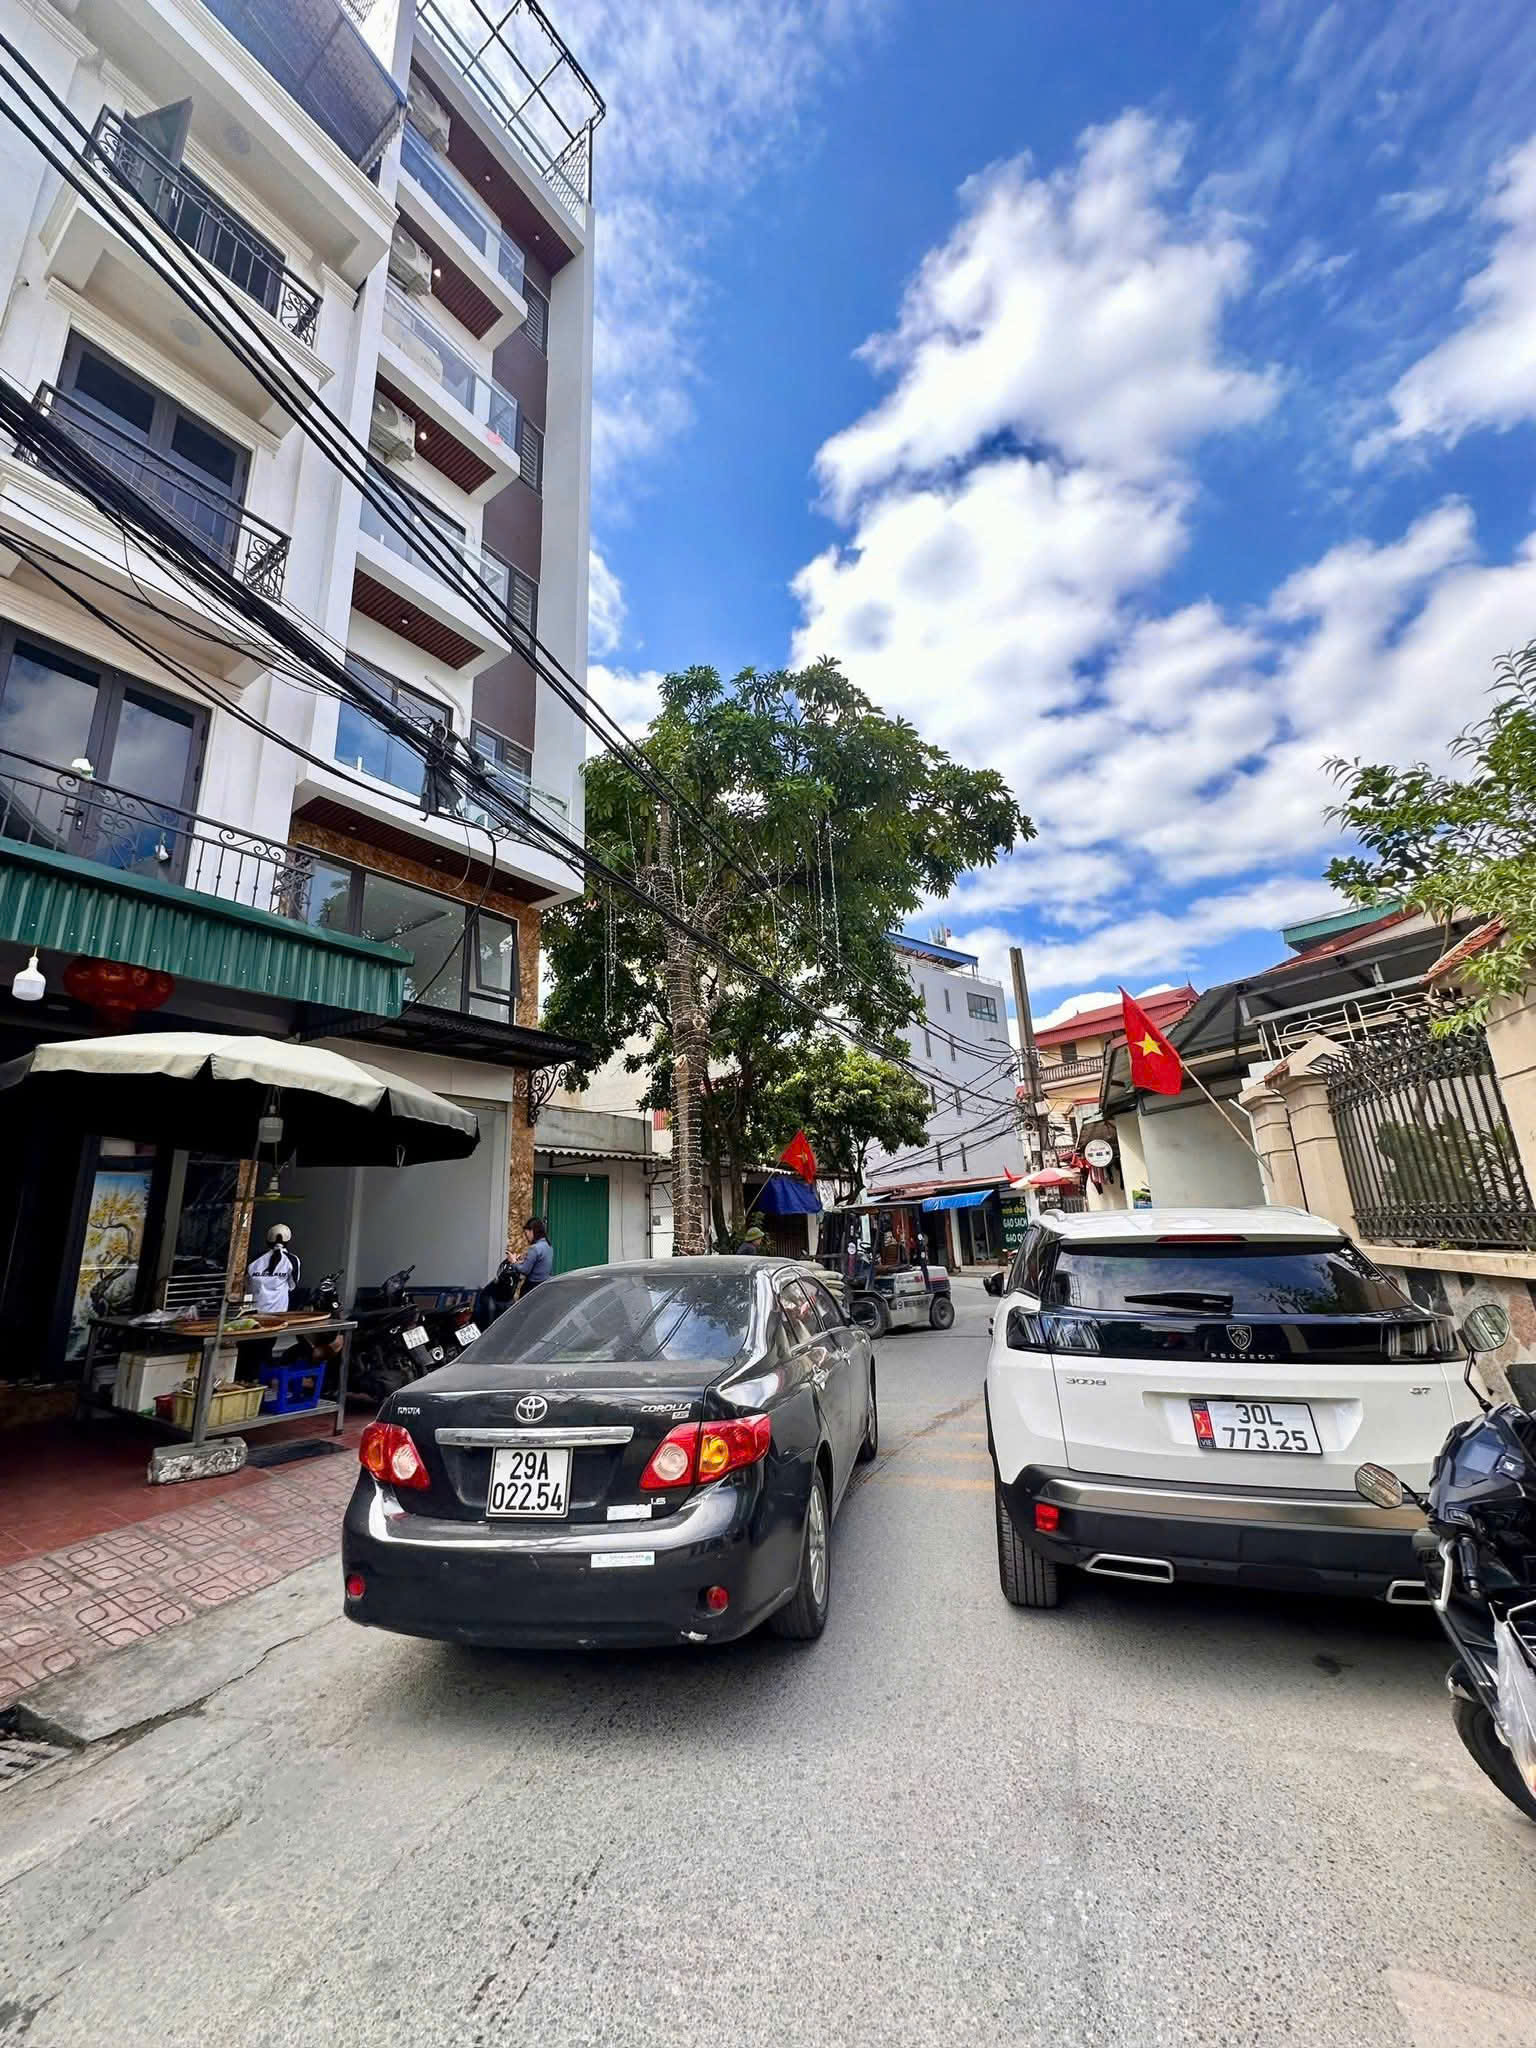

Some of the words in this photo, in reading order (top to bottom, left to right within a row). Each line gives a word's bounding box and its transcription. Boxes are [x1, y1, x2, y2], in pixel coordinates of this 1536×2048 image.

[1210, 1352, 1275, 1360] PEUGEOT
[1065, 1377, 1106, 1386] 3008
[397, 1406, 420, 1416] TOYOTA
[640, 1402, 692, 1413] COROLLA
[1235, 1404, 1283, 1426] 30L
[1222, 1426, 1308, 1451] 773.25
[510, 1451, 548, 1480] 29A
[492, 1482, 563, 1511] 022.54
